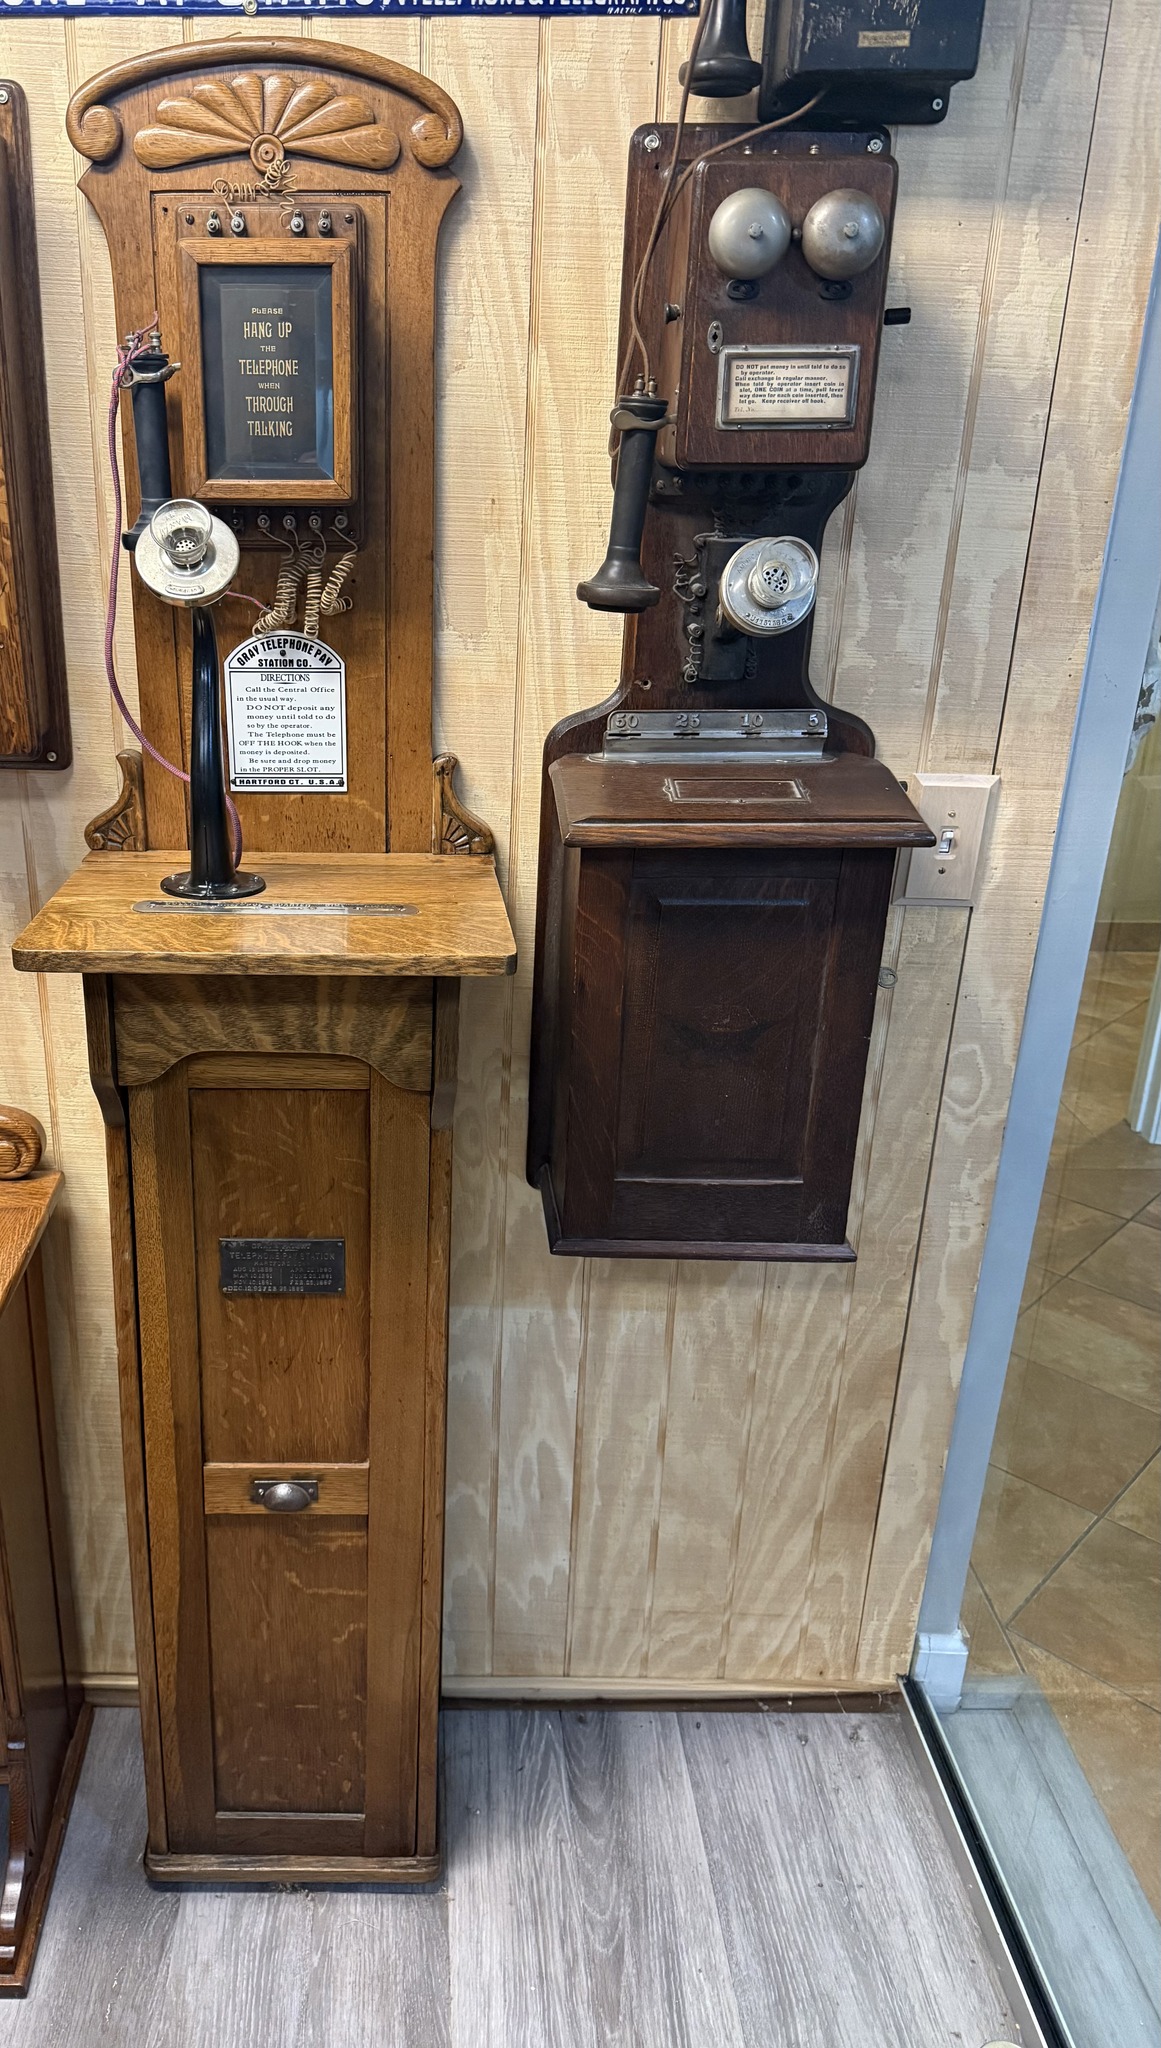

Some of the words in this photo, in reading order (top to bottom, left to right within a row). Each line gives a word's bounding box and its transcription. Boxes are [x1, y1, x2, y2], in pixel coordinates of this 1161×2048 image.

[244, 322, 272, 339] HANG
[278, 322, 292, 338] UP
[239, 359, 298, 376] TELEPHONE
[246, 396, 293, 413] THROUGH
[247, 420, 292, 438] TALKING
[260, 638, 314, 655] TELEPHONE
[314, 648, 333, 666] PAY
[258, 659, 294, 667] STATION
[297, 659, 311, 667] CO.
[615, 714, 639, 728] 50
[676, 714, 700, 728] 25
[742, 714, 763, 727] 10
[809, 714, 819, 726] 5
